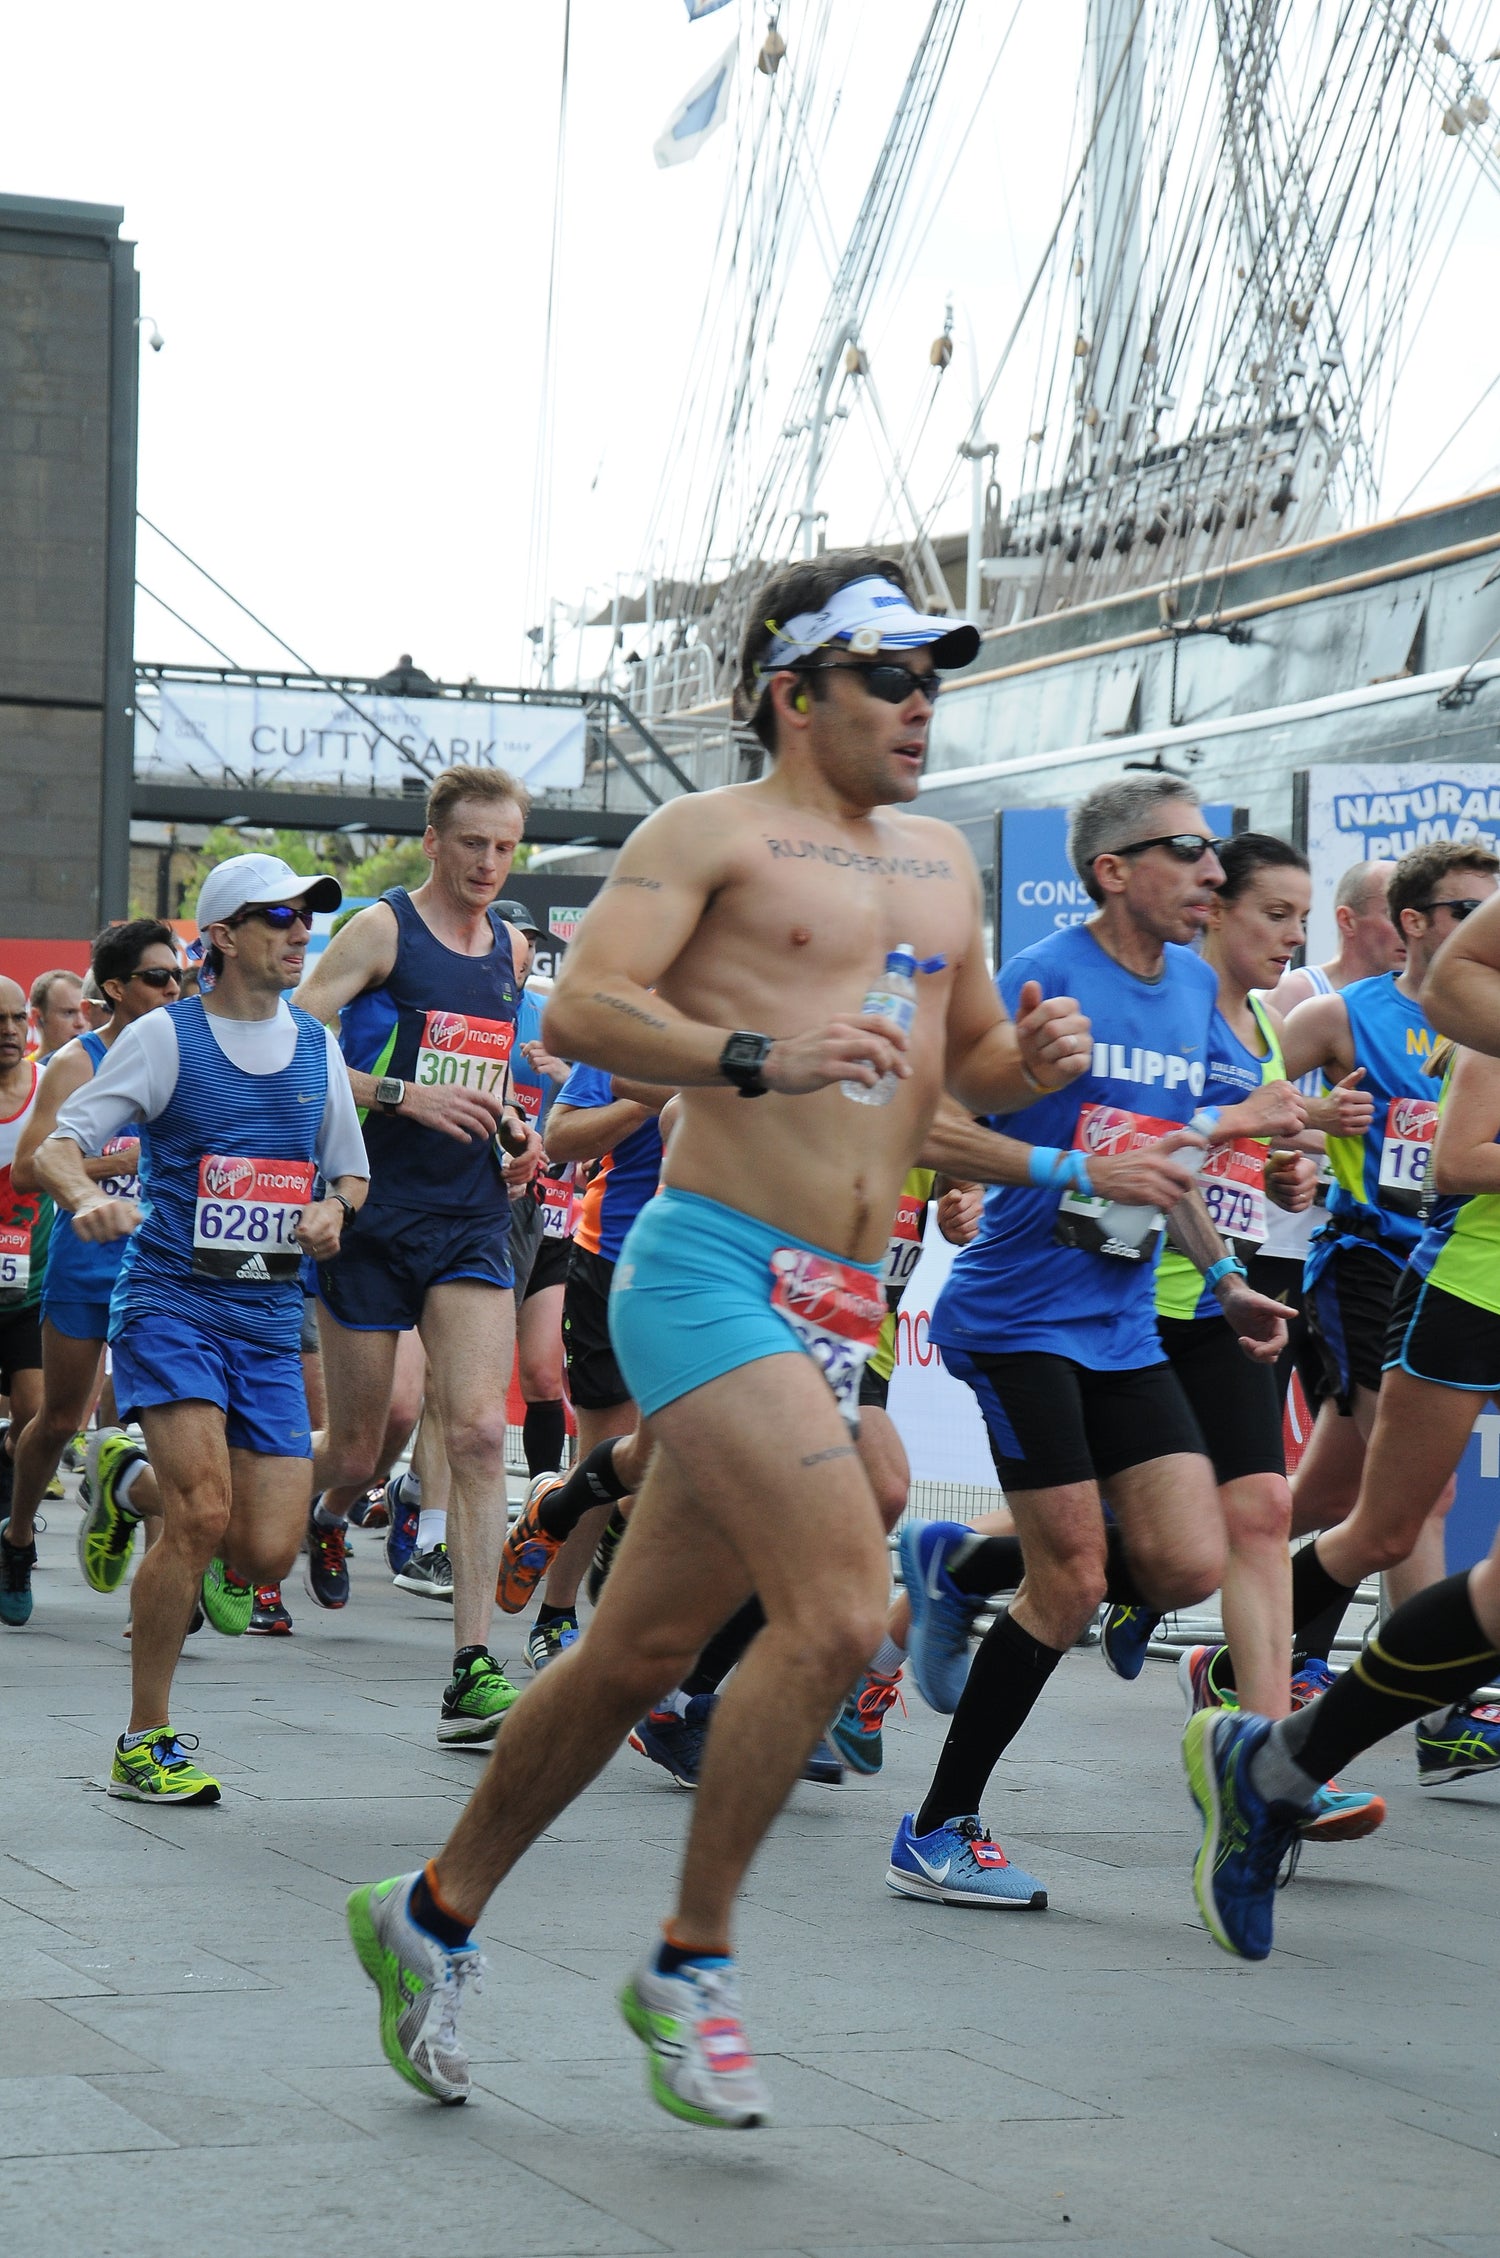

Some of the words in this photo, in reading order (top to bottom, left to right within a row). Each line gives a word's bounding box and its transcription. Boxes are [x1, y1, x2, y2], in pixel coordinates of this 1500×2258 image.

[251, 725, 385, 761] CUTTY
[398, 734, 497, 766] SARK
[1337, 784, 1500, 828] NATURAL
[766, 839, 955, 881] RUNDERWEAR
[431, 1021, 465, 1048] Virgin
[468, 1029, 512, 1050] money
[420, 1052, 503, 1093] 30117
[1395, 1107, 1438, 1139] Virgin
[208, 1160, 252, 1197] Virgin
[257, 1173, 309, 1195] money
[200, 1203, 303, 1245] 62813
[236, 1268, 271, 1280] adidas
